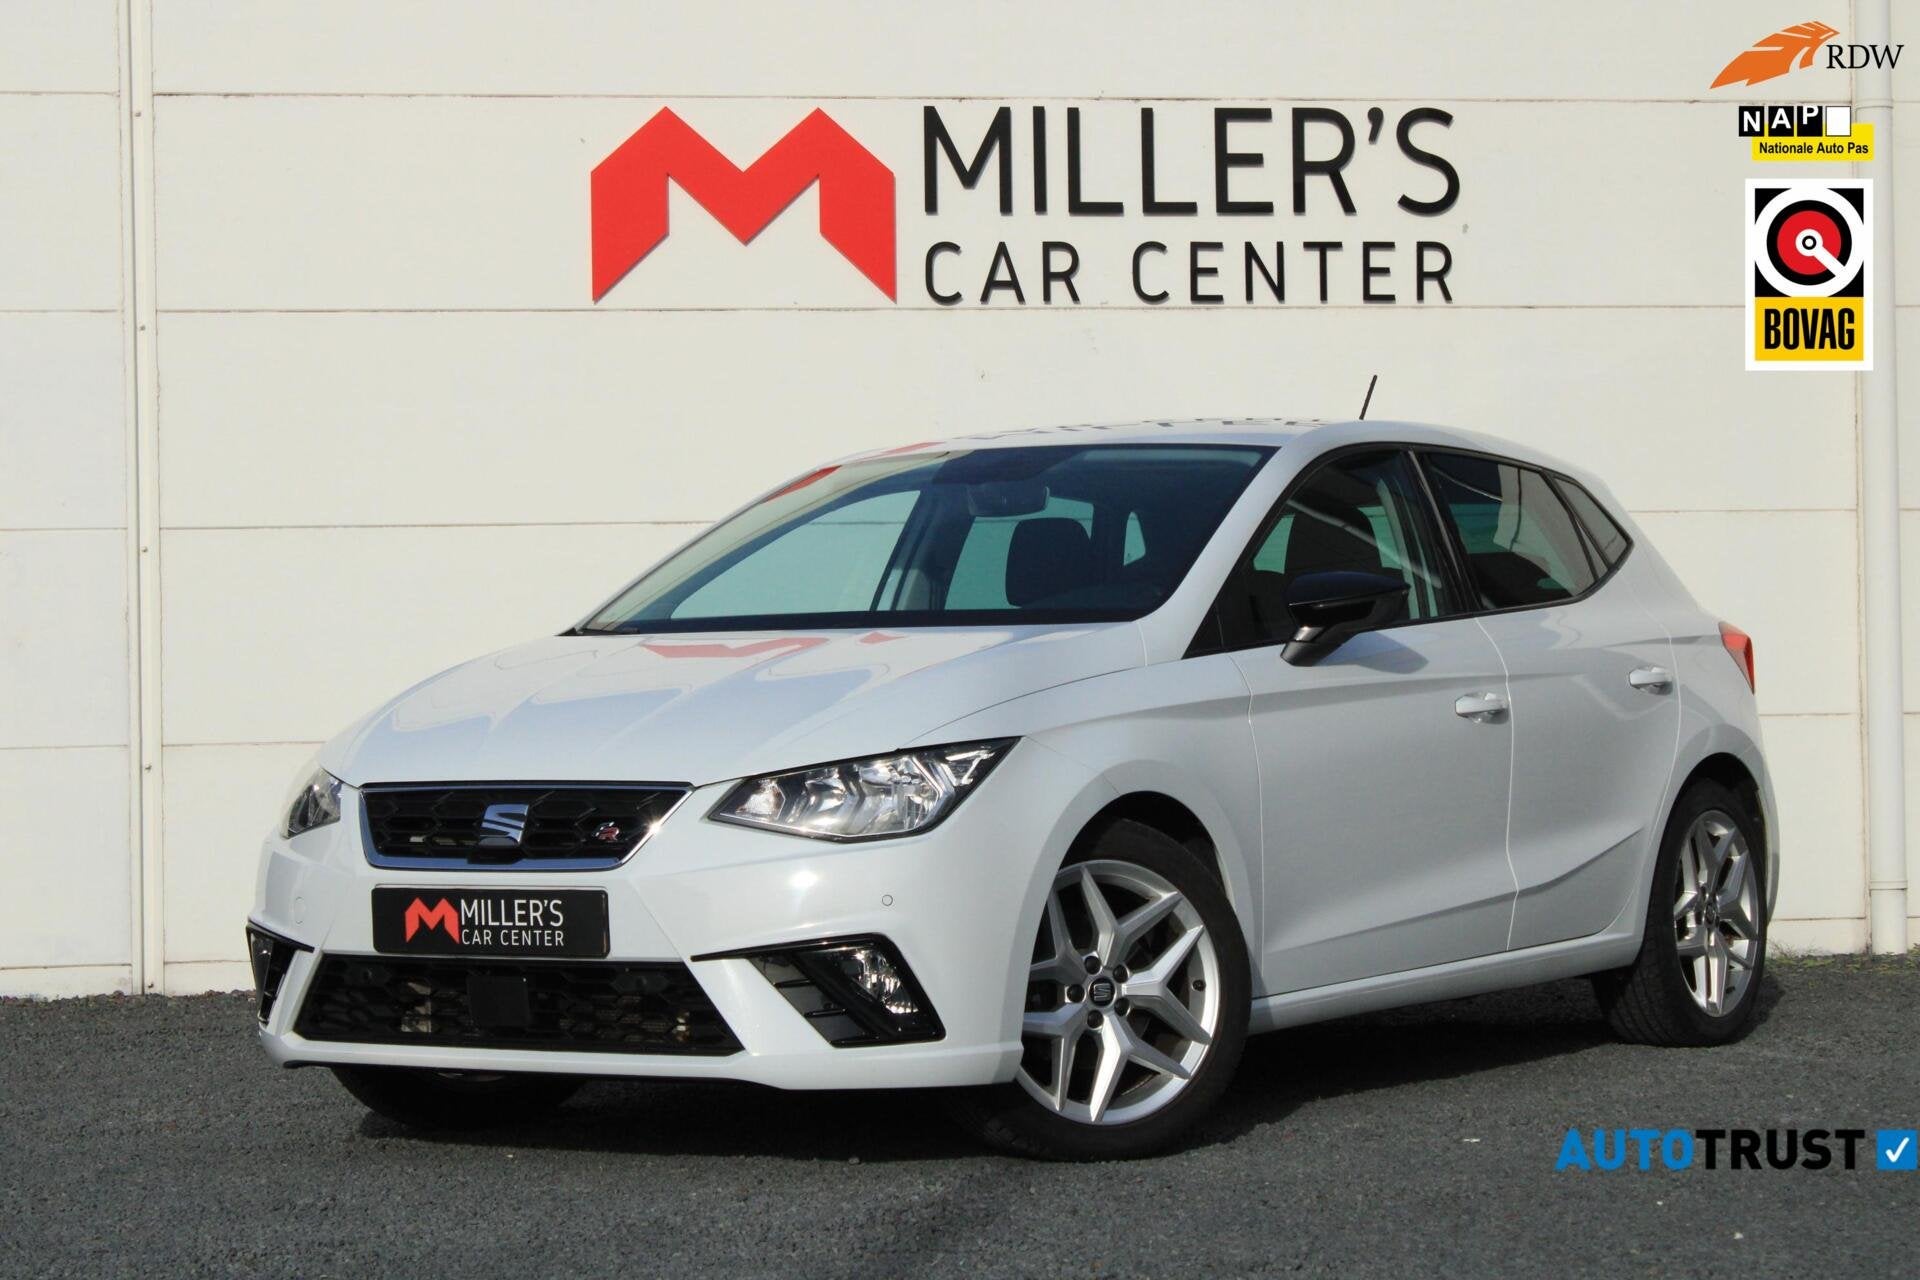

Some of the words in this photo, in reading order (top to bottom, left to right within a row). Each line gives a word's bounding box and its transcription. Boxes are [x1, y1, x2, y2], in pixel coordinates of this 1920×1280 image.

[924, 105, 1461, 216] MILLER'S
[924, 240, 1081, 305] CAR
[1132, 240, 1454, 305] CENTER
[460, 898, 564, 927] MILLER'S
[461, 929, 492, 946] CAR
[500, 929, 565, 947] CENTER
